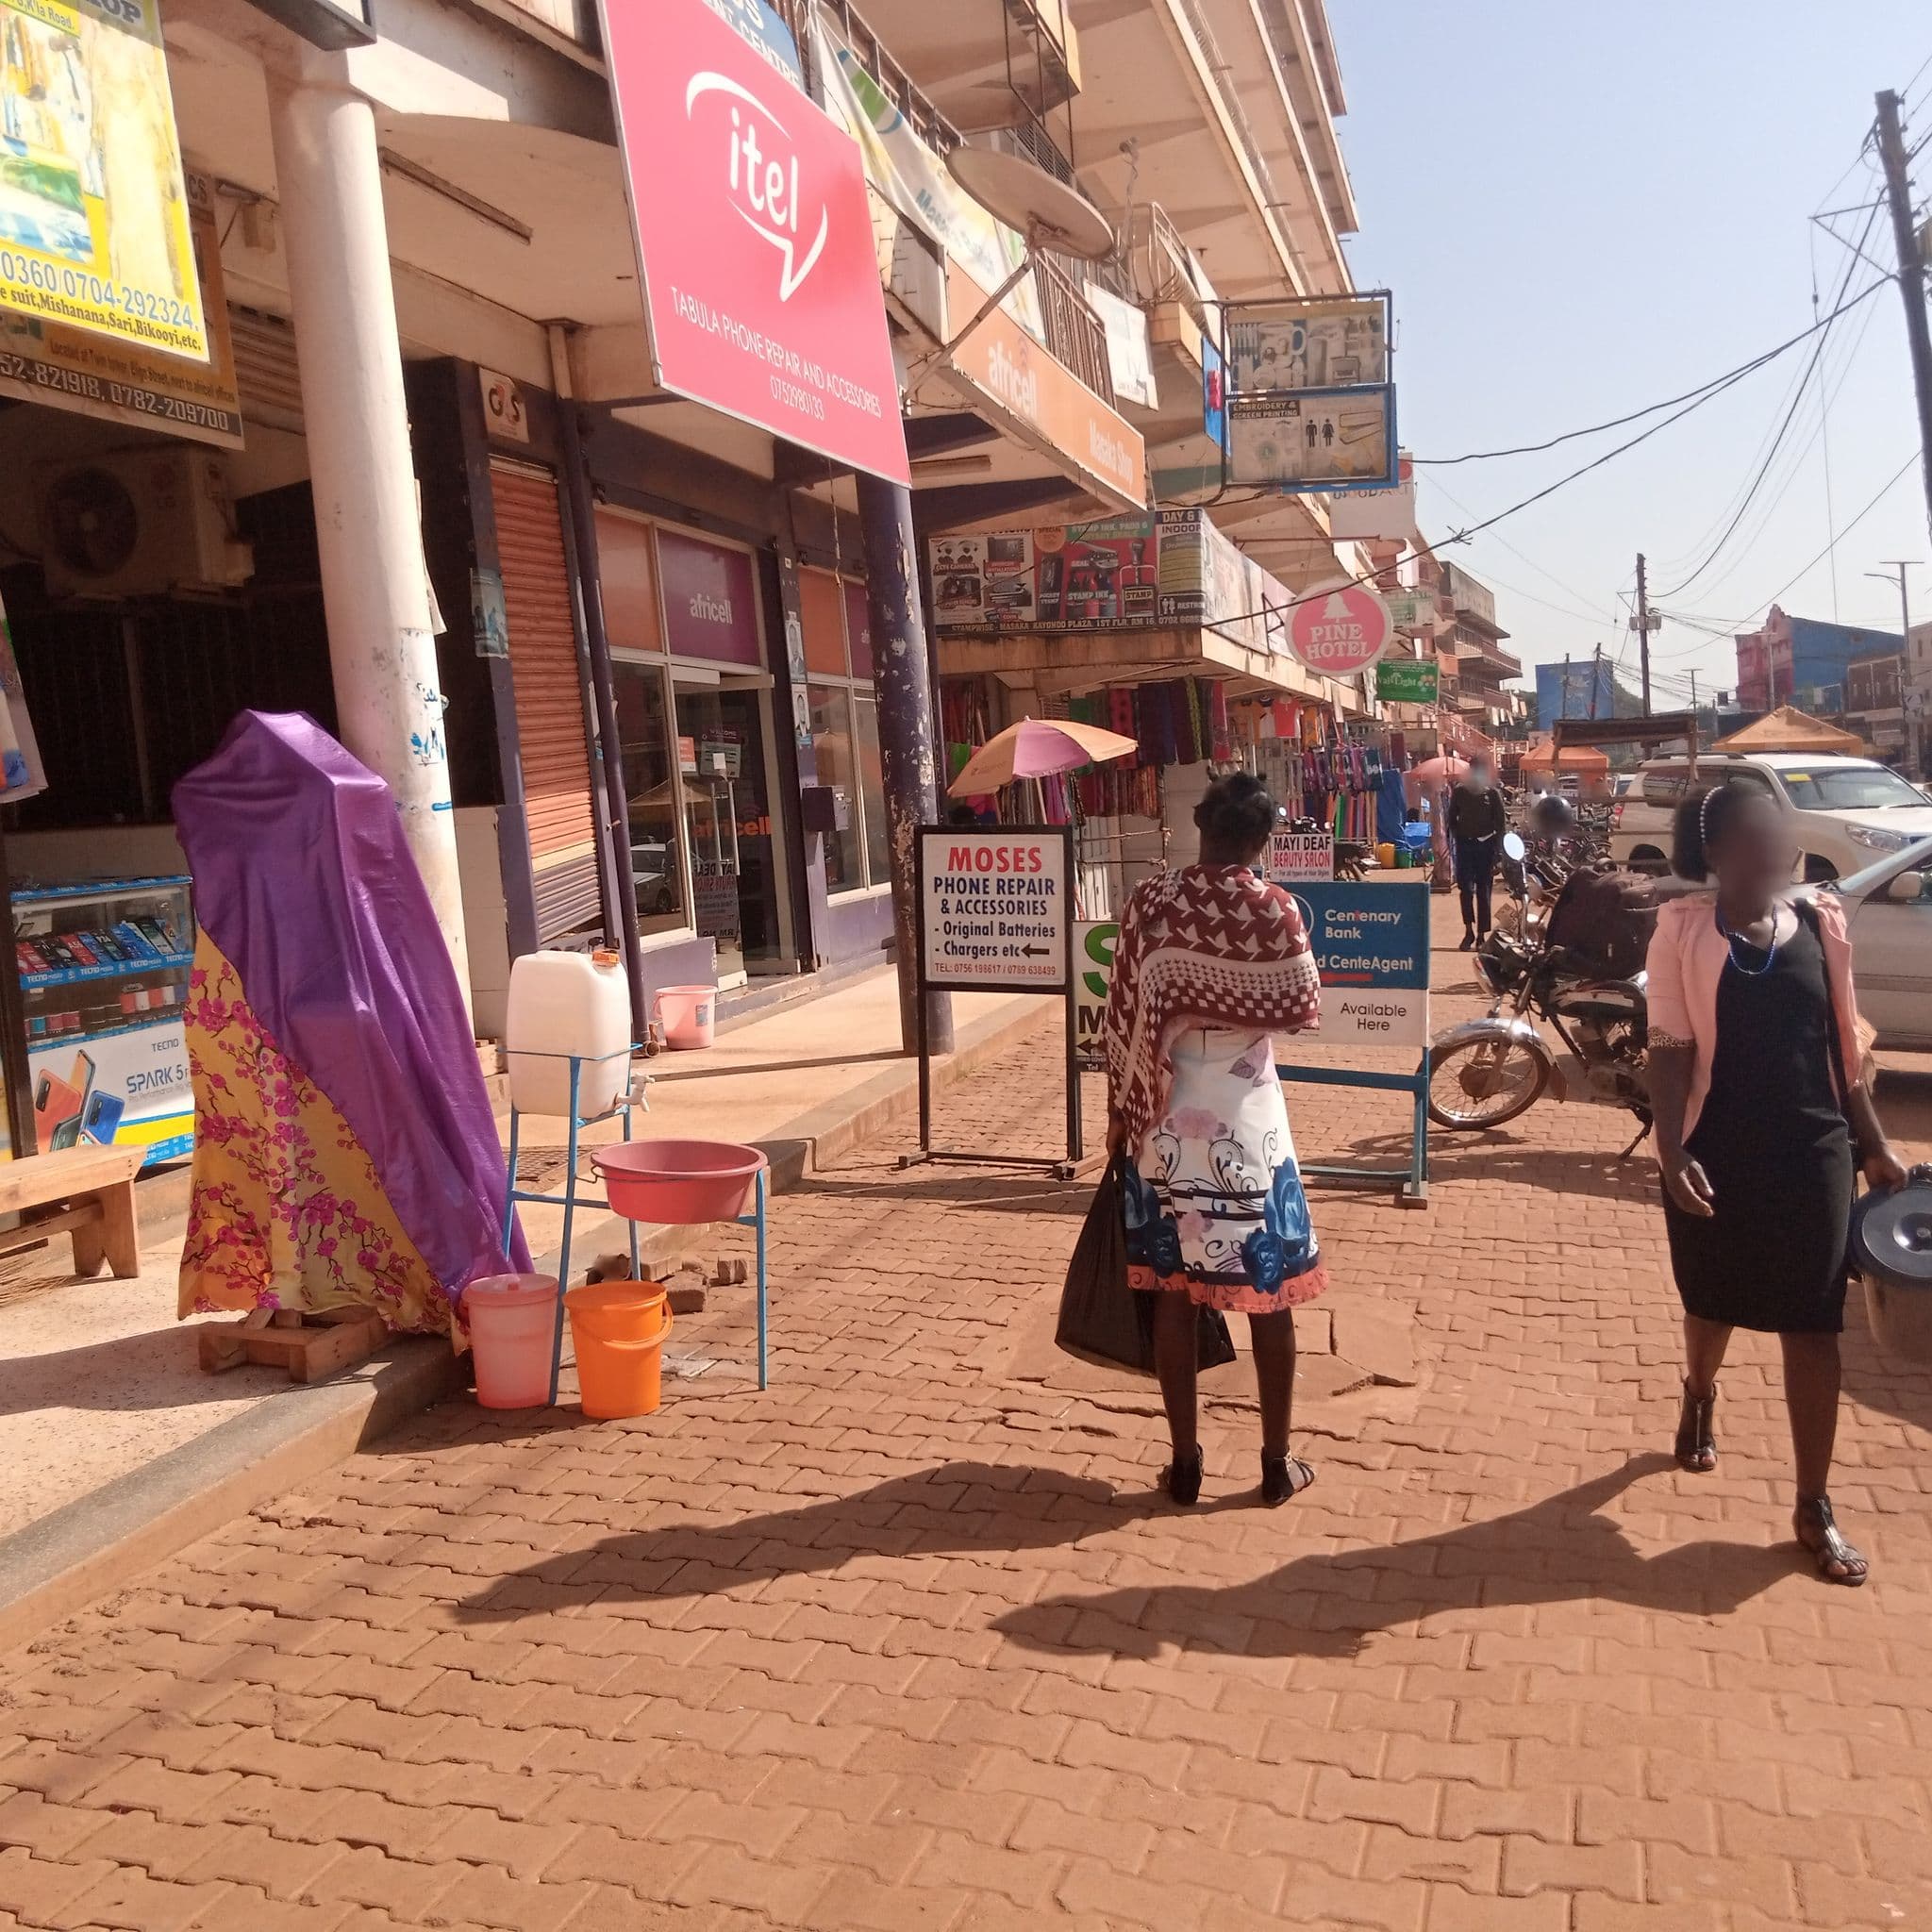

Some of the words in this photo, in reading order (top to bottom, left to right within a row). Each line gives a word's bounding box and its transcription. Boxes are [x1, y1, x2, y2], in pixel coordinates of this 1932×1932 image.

[721, 107, 799, 233] itel
[672, 286, 723, 338] TABULA
[722, 314, 765, 360] PHONE
[766, 339, 802, 378] REPAIR
[803, 358, 824, 390] AND
[826, 374, 882, 418] ACCESSORIES
[988, 341, 1037, 423] africell
[110, 383, 229, 431] 0782-209700
[1233, 402, 1286, 411] EMBROIDERY
[1162, 511, 1184, 524] DAY
[1067, 591, 1094, 601] STAMP
[1125, 590, 1152, 600] STAMP
[690, 593, 733, 625] africell
[952, 624, 993, 632] STAMPWISE
[1097, 618, 1111, 627] 1ST
[1310, 624, 1363, 642] PINE
[1306, 641, 1372, 659] HOTEL
[1274, 837, 1300, 851] MAYI
[1304, 836, 1330, 851] DEAF
[948, 846, 1042, 874] MOSES
[1274, 852, 1302, 868] BEAUTY
[1305, 852, 1330, 868] SALON
[934, 877, 990, 895] PHONE
[996, 878, 1056, 896] REPAIR
[941, 898, 950, 915] &
[956, 899, 1048, 916] ACCESSORIES
[1324, 908, 1402, 925] Centenary
[943, 920, 993, 939] Original
[998, 921, 1056, 938] Batteries
[1324, 926, 1362, 940] Bank
[944, 941, 998, 959] Chargers
[1002, 943, 1021, 958] etc
[935, 963, 953, 973] TEL:
[1329, 955, 1413, 973] CenteAgent
[1340, 1003, 1407, 1017] Available
[1357, 1018, 1391, 1031] Here
[151, 1039, 179, 1053] TECNO
[126, 1067, 174, 1093] SPARK
[175, 1064, 184, 1080] 5
